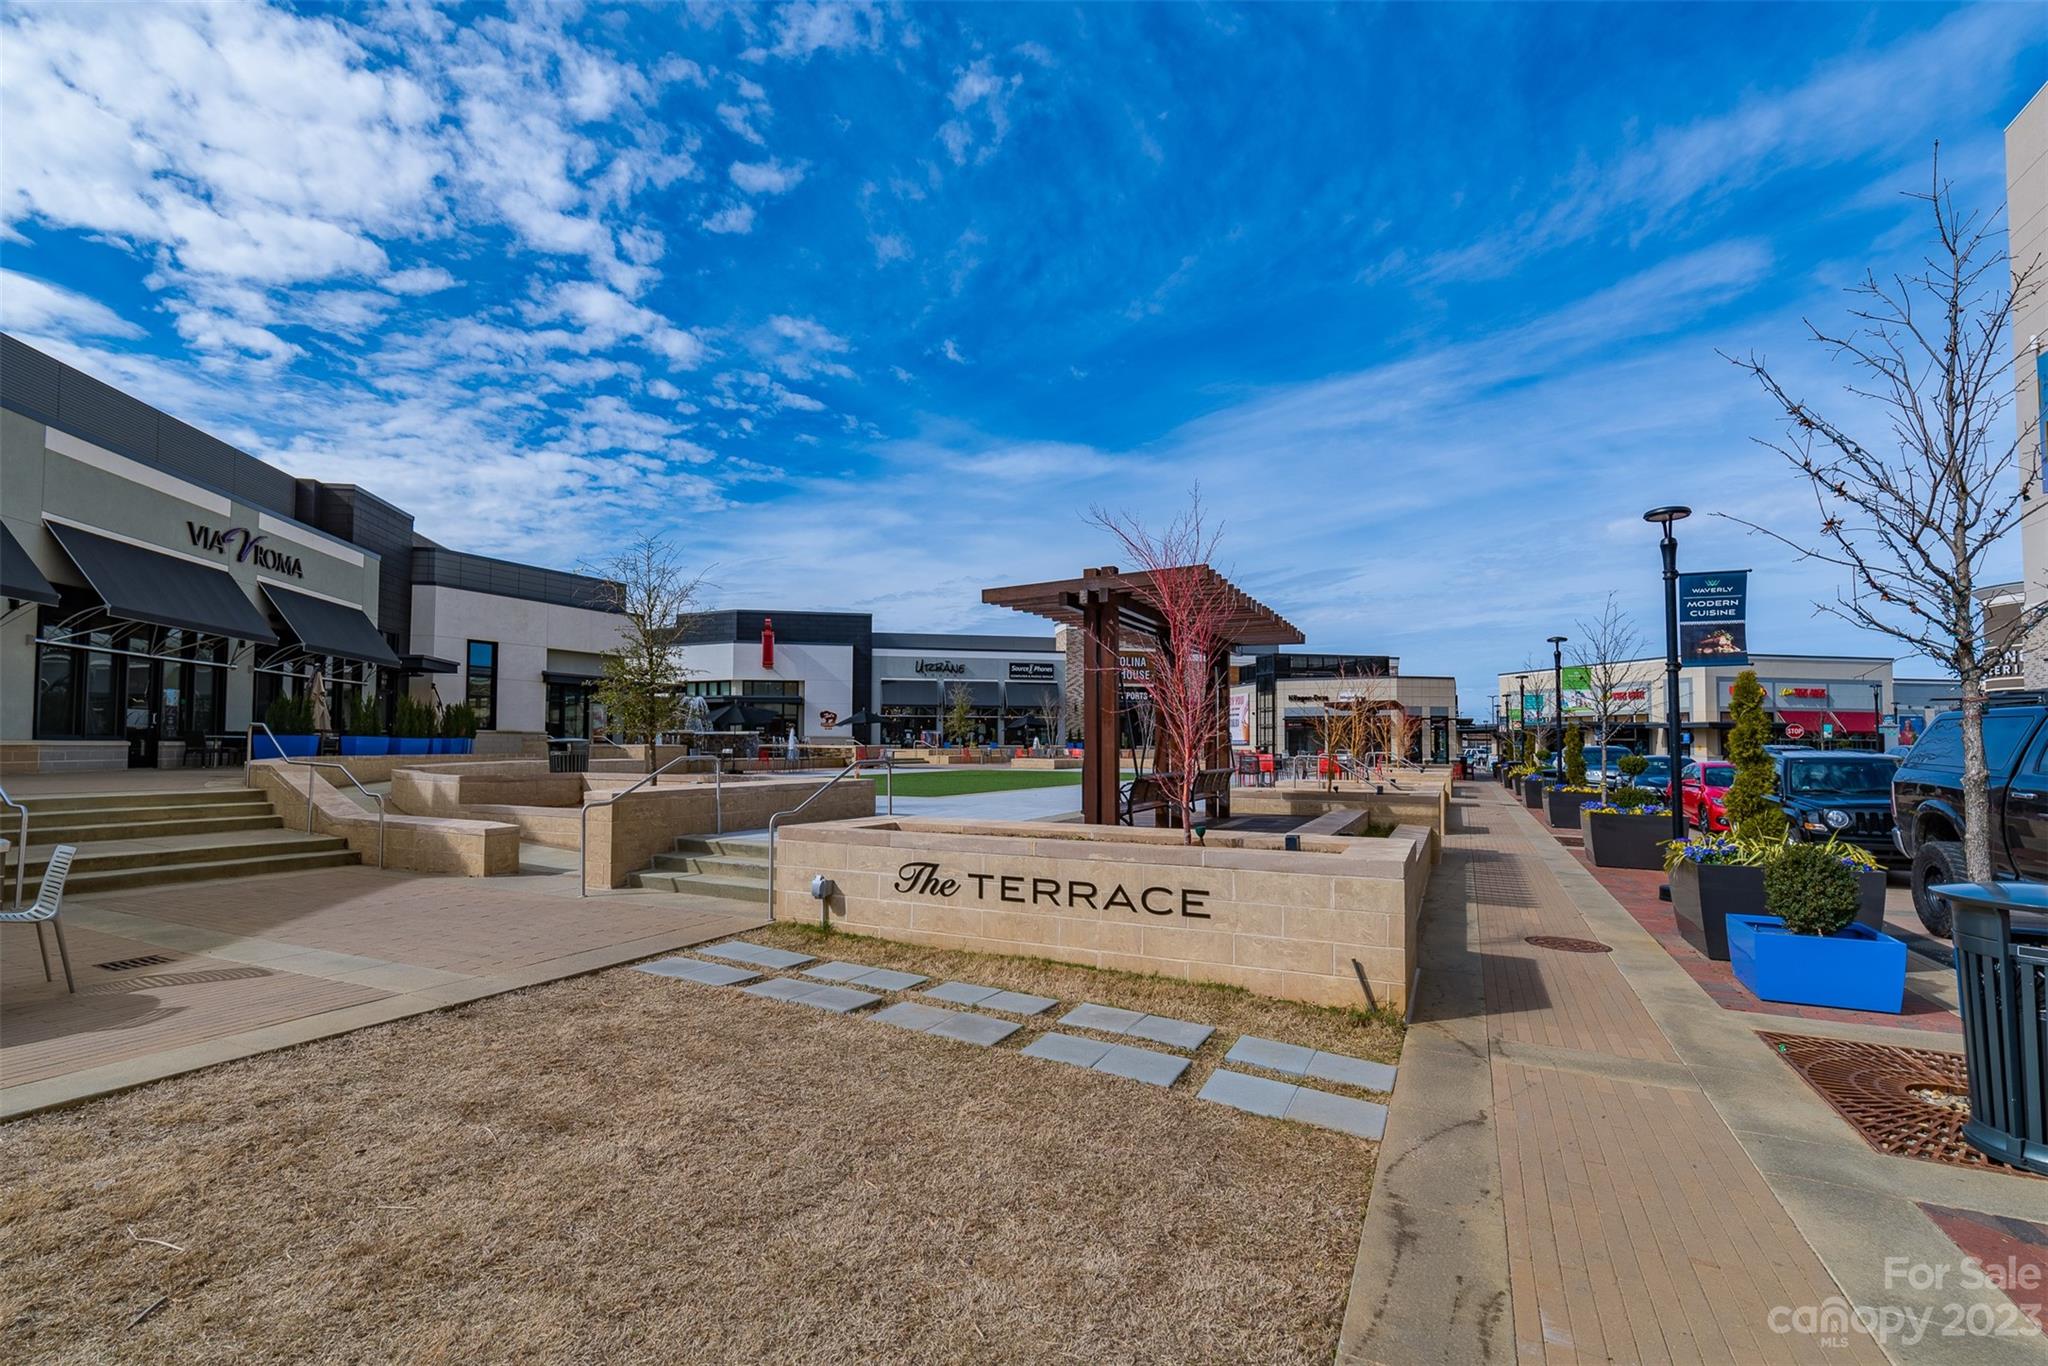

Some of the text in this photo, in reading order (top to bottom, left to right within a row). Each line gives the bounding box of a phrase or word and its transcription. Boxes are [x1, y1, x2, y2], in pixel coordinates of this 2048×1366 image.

[186, 521, 225, 555] VIA
[254, 544, 304, 579] ROMA
[1687, 599, 1739, 608] MODERN
[1690, 608, 1737, 617] CUISINE
[1119, 656, 1147, 667] OLINA
[1787, 727, 1804, 735] STOP
[893, 861, 1212, 919] The TERRACE
